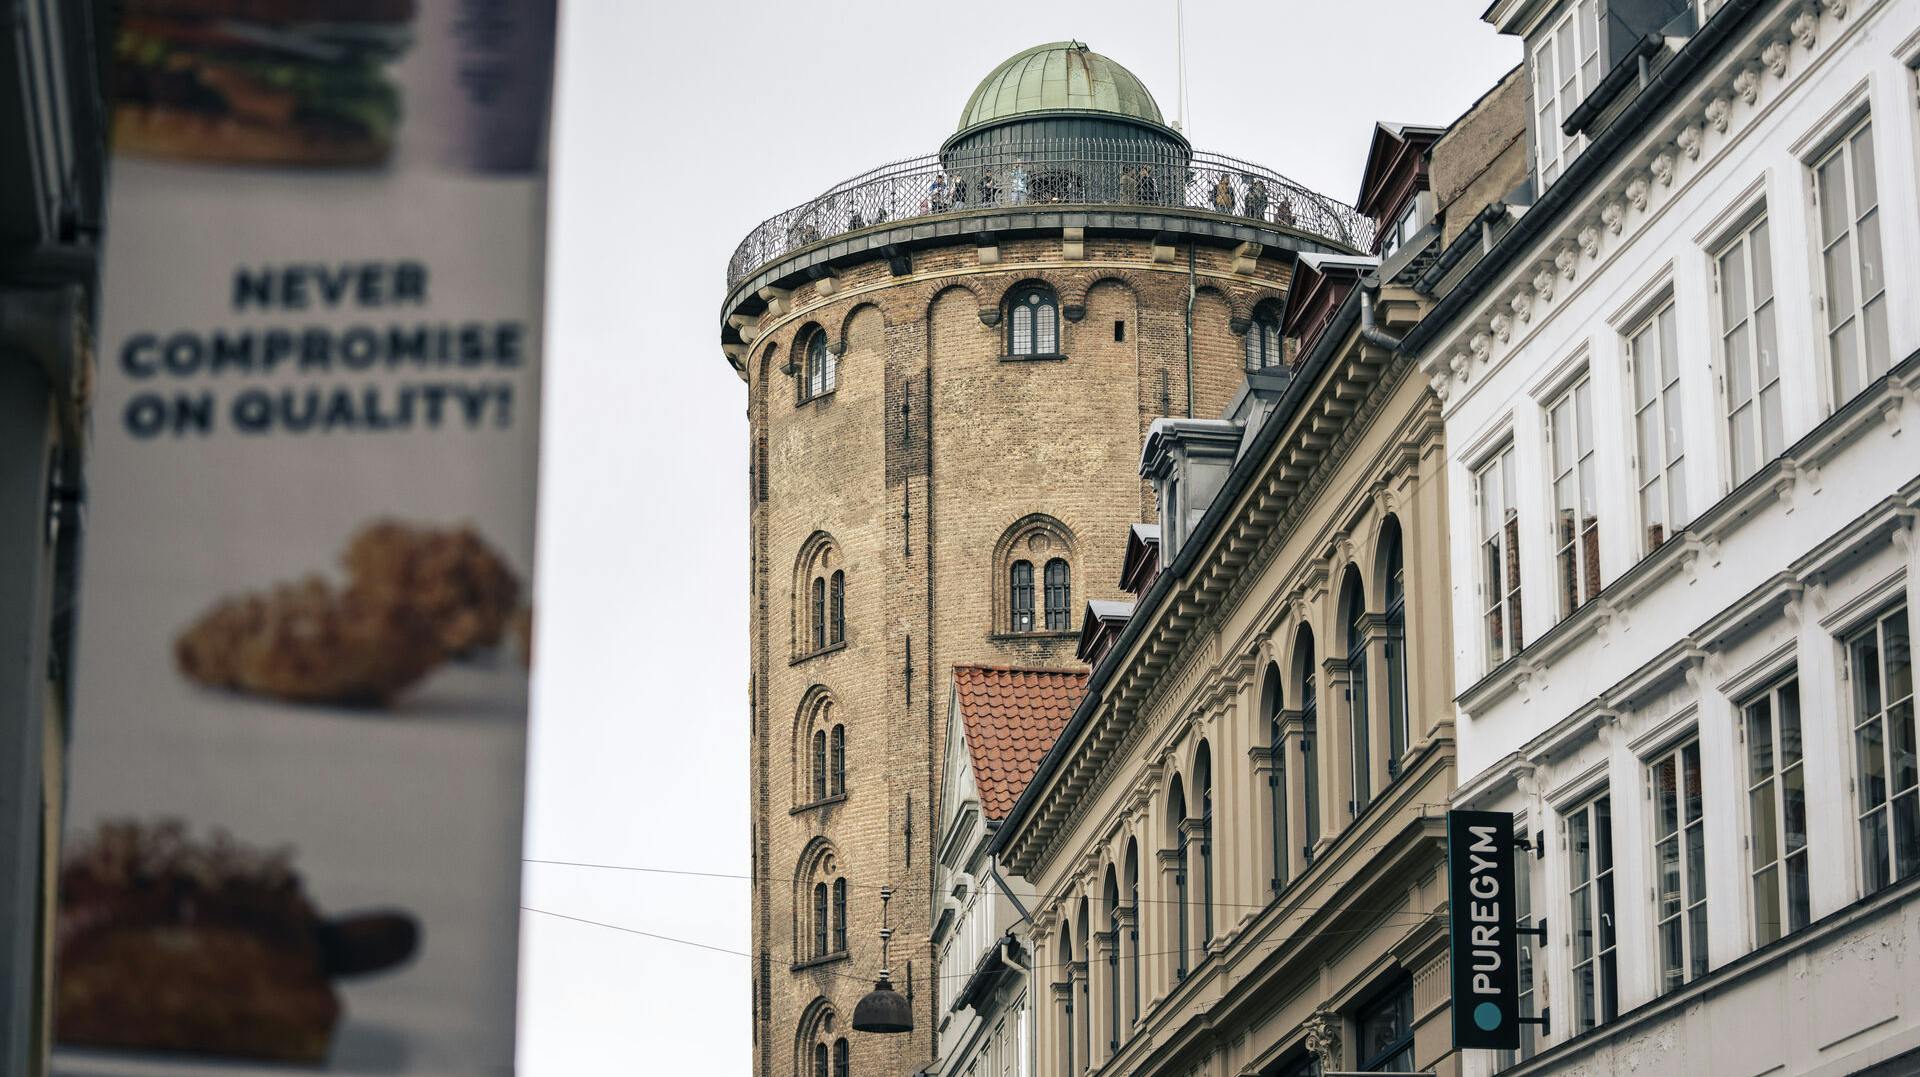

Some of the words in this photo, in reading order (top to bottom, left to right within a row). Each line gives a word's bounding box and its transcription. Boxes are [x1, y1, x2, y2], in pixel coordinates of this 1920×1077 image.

[233, 262, 427, 309] NEVER
[121, 322, 523, 377] COMPROMISE
[123, 390, 215, 438] ON
[231, 384, 513, 435] QUALITY!
[1469, 826, 1501, 994] PUREGYM
